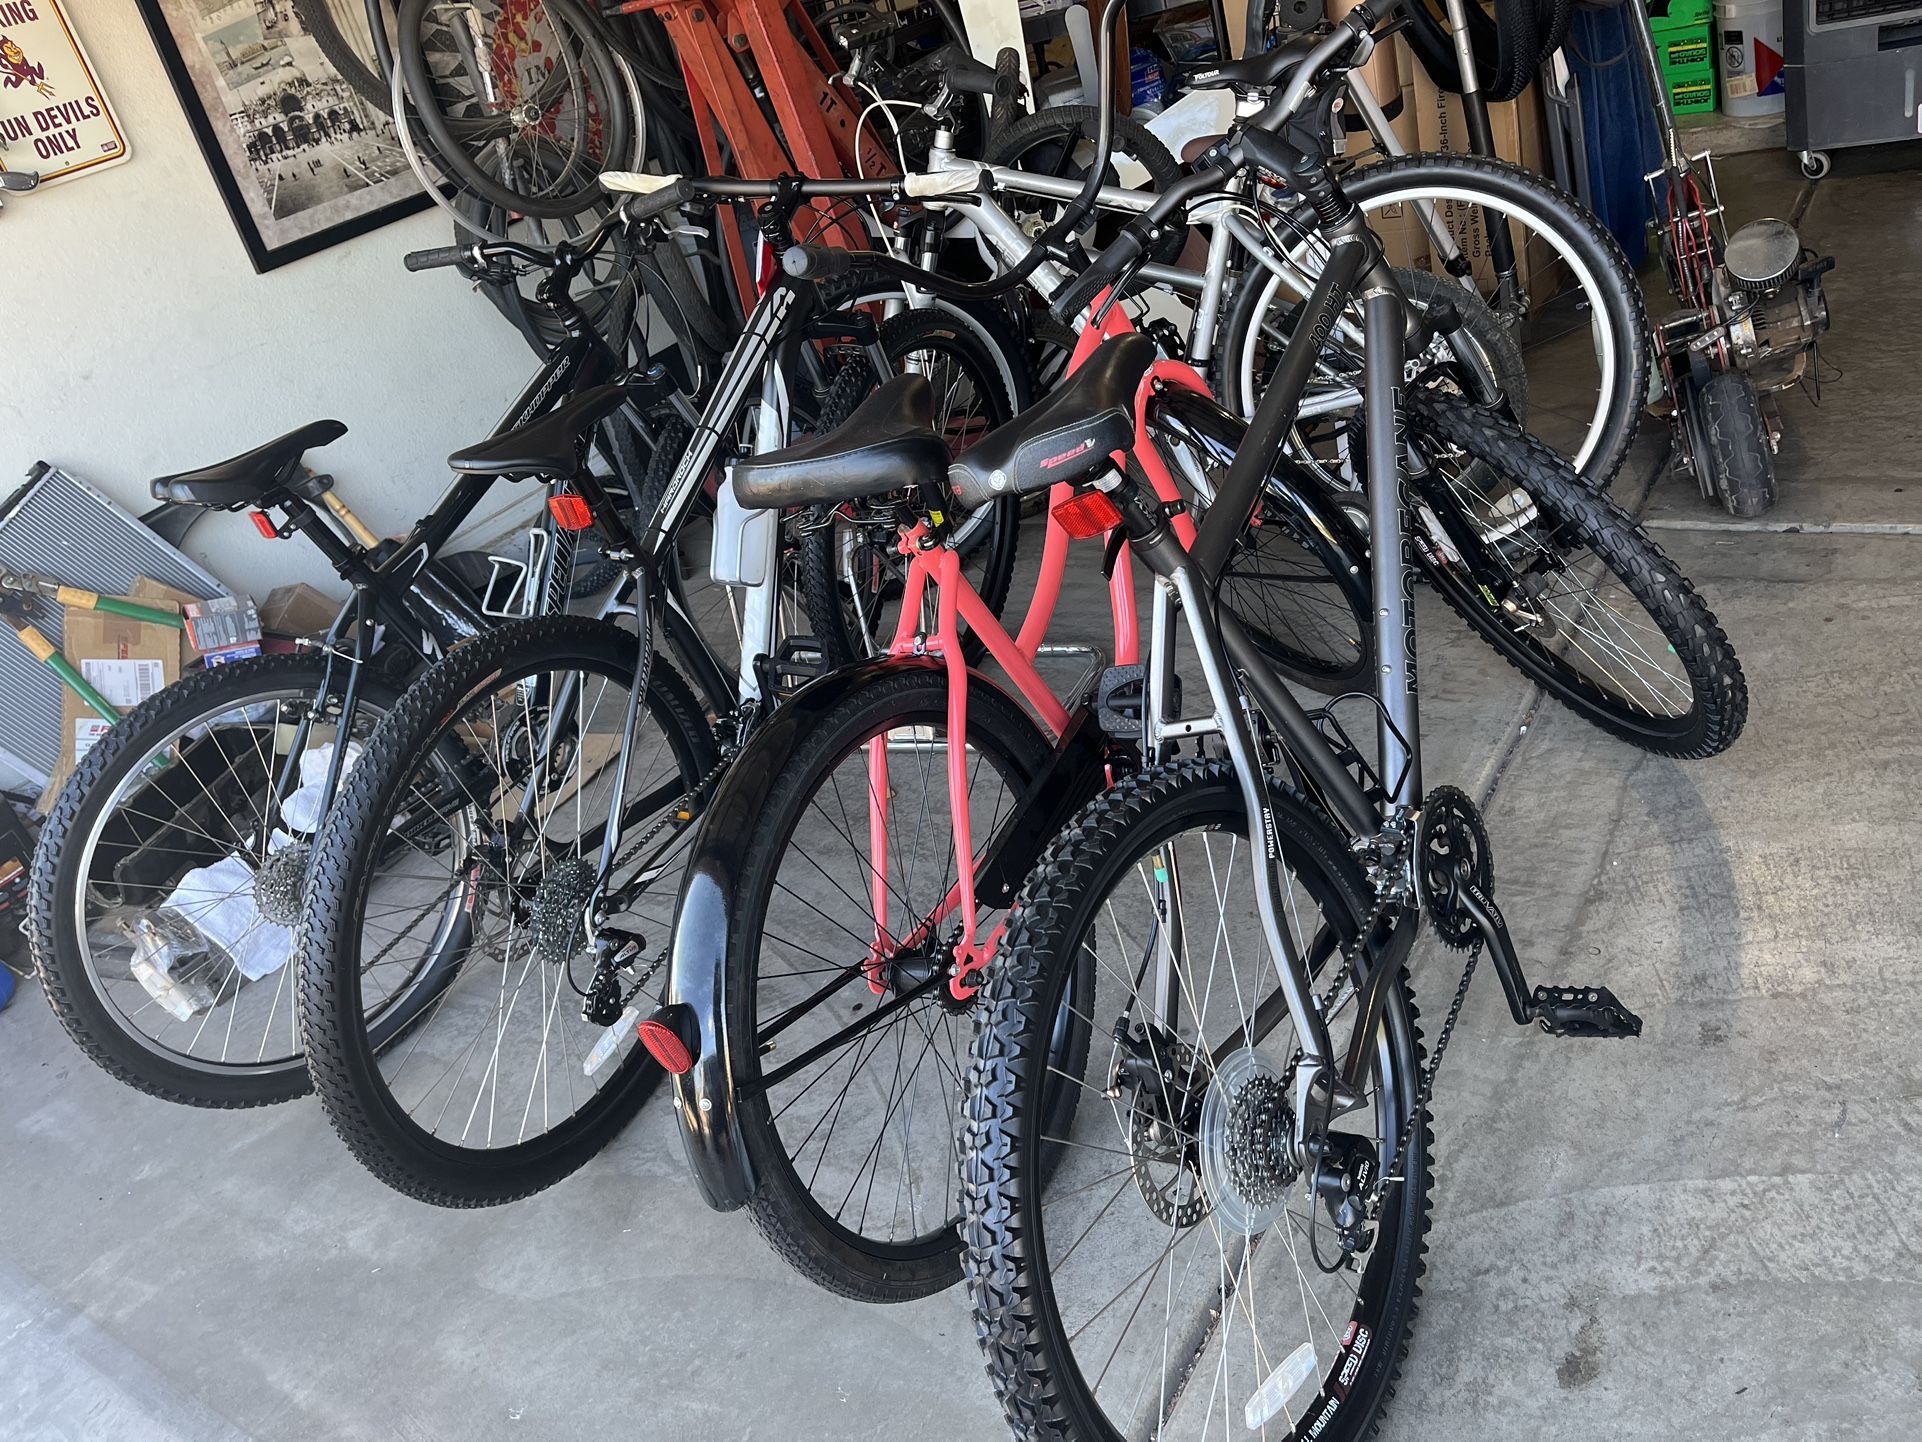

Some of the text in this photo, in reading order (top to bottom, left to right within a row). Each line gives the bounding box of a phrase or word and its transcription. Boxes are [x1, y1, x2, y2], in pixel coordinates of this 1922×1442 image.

[32, 96, 101, 133] DEVILS
[1439, 111, 1450, 151] 36-Inch
[33, 128, 82, 160] ONLY
[1472, 227, 1481, 258] Gross
[1309, 281, 1344, 352] 400 HT
[1426, 551, 1440, 566] DISC
[1263, 807, 1275, 859] POWERSTAY
[1359, 1160, 1370, 1190] ALIVIO
[1308, 1327, 1369, 1440] MOUNTAIN SPEED DISC
